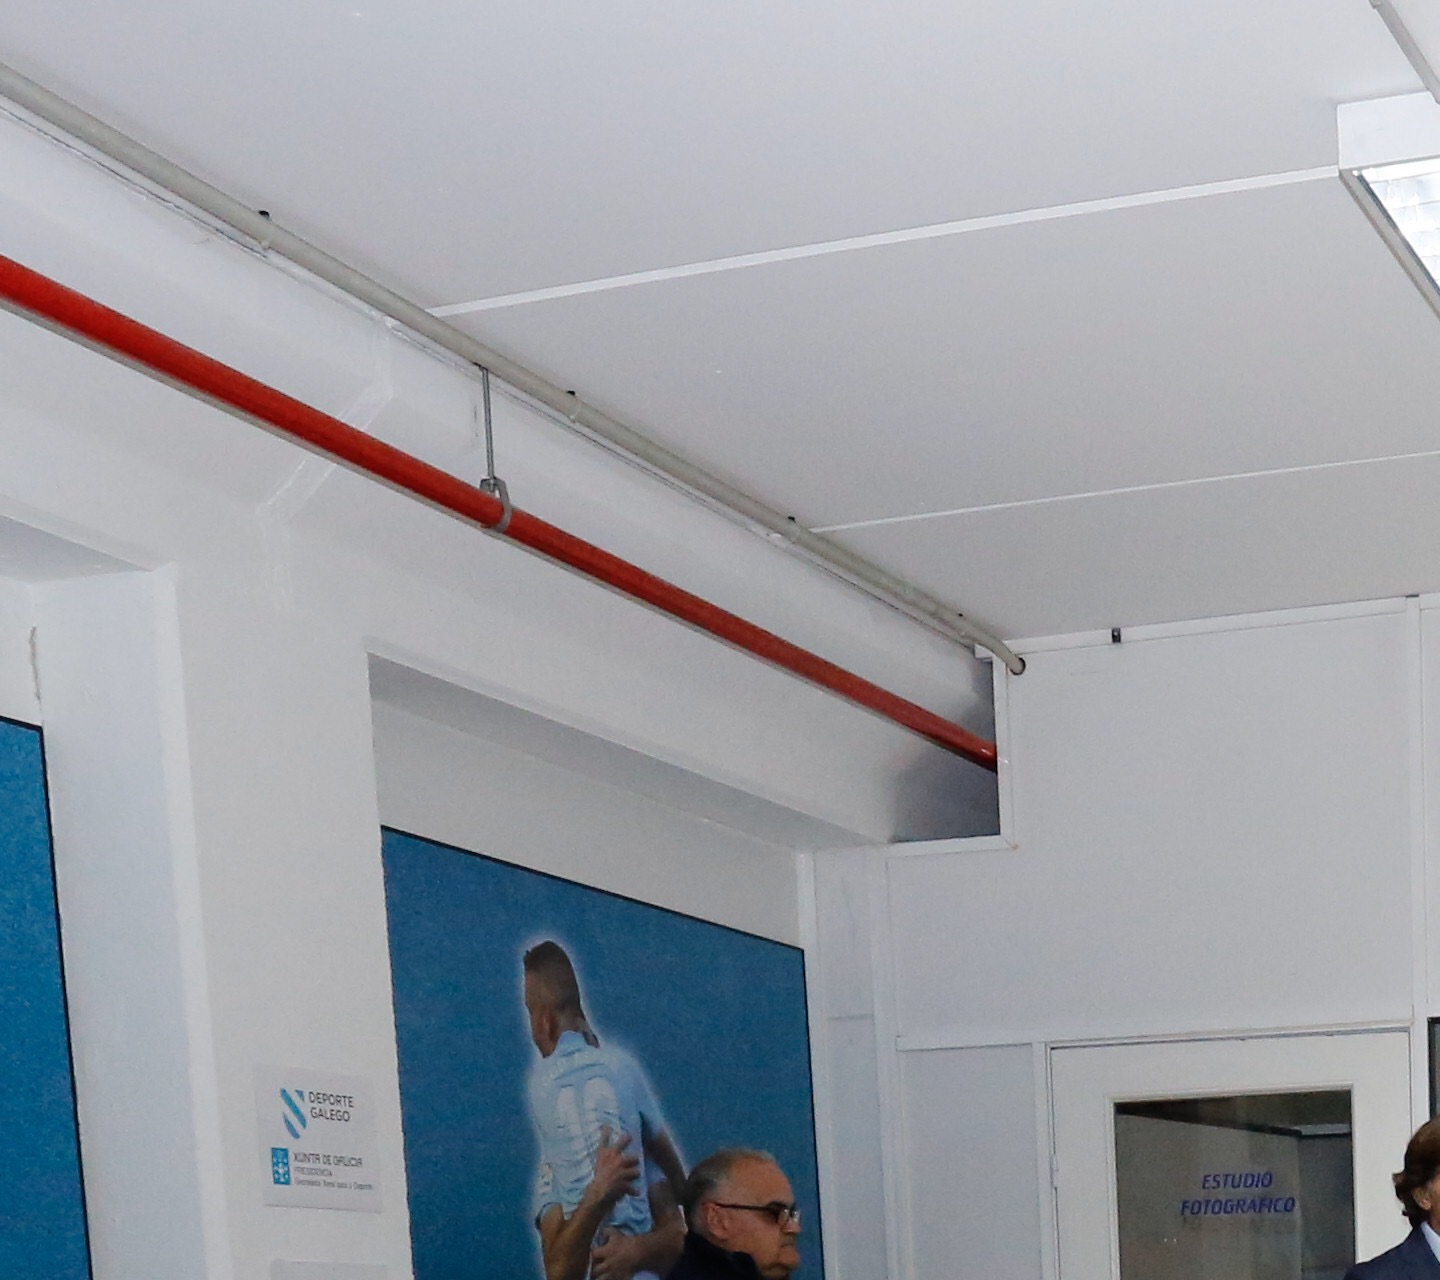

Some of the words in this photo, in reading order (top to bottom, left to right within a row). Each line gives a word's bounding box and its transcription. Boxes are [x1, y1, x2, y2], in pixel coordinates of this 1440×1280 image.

[308, 1091, 354, 1108] DEPORTE
[310, 1107, 350, 1122] GALEGO
[1202, 1172, 1273, 1190] ESTUDIO
[1181, 1197, 1295, 1215] FOTOGRAFICO
